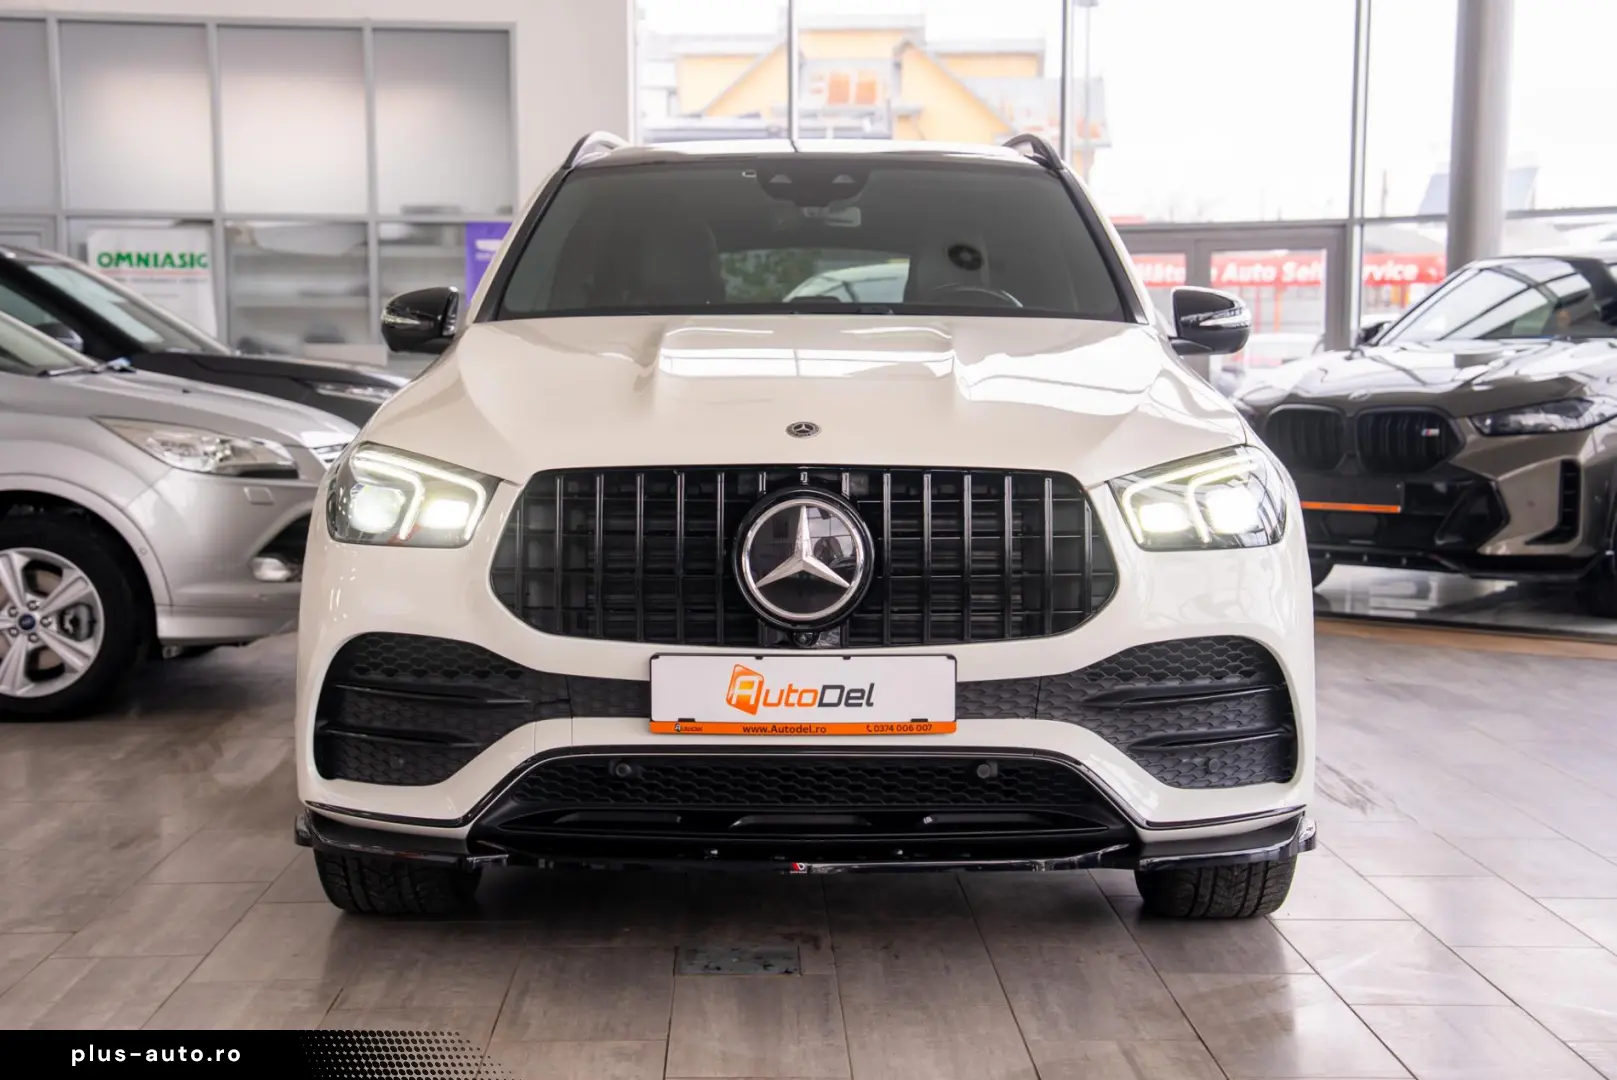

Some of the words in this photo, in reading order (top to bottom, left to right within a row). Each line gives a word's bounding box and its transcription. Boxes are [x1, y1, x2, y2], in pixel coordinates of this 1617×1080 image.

[1221, 261, 1277, 283] Auto
[727, 666, 875, 714] AutoDel
[742, 724, 827, 734] www.Autodel.ro
[873, 724, 894, 733] 0374
[896, 724, 914, 732] 006
[916, 723, 933, 732] 007
